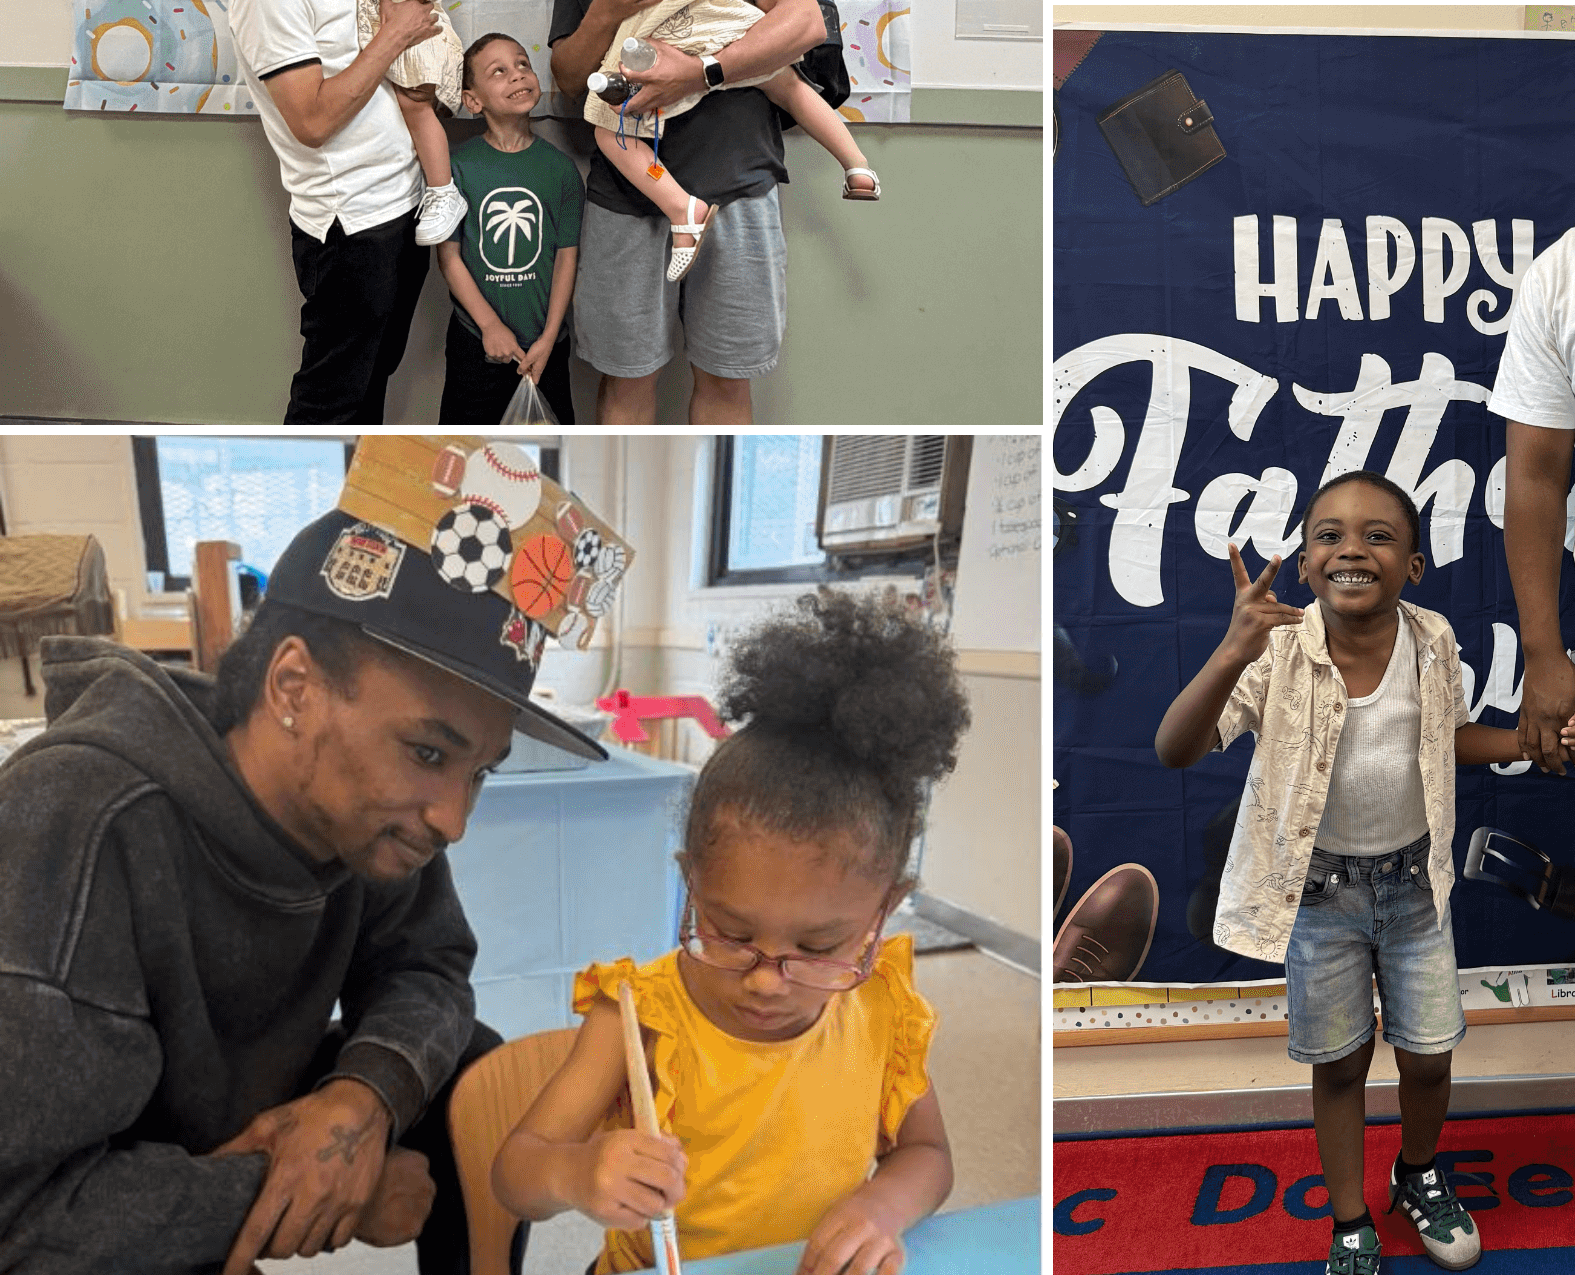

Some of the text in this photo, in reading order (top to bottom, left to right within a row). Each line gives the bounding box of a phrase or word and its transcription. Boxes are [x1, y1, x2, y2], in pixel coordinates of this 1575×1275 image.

[485, 272, 536, 283] JOYFUL DAYS
[1232, 213, 1535, 337] HAPPY
